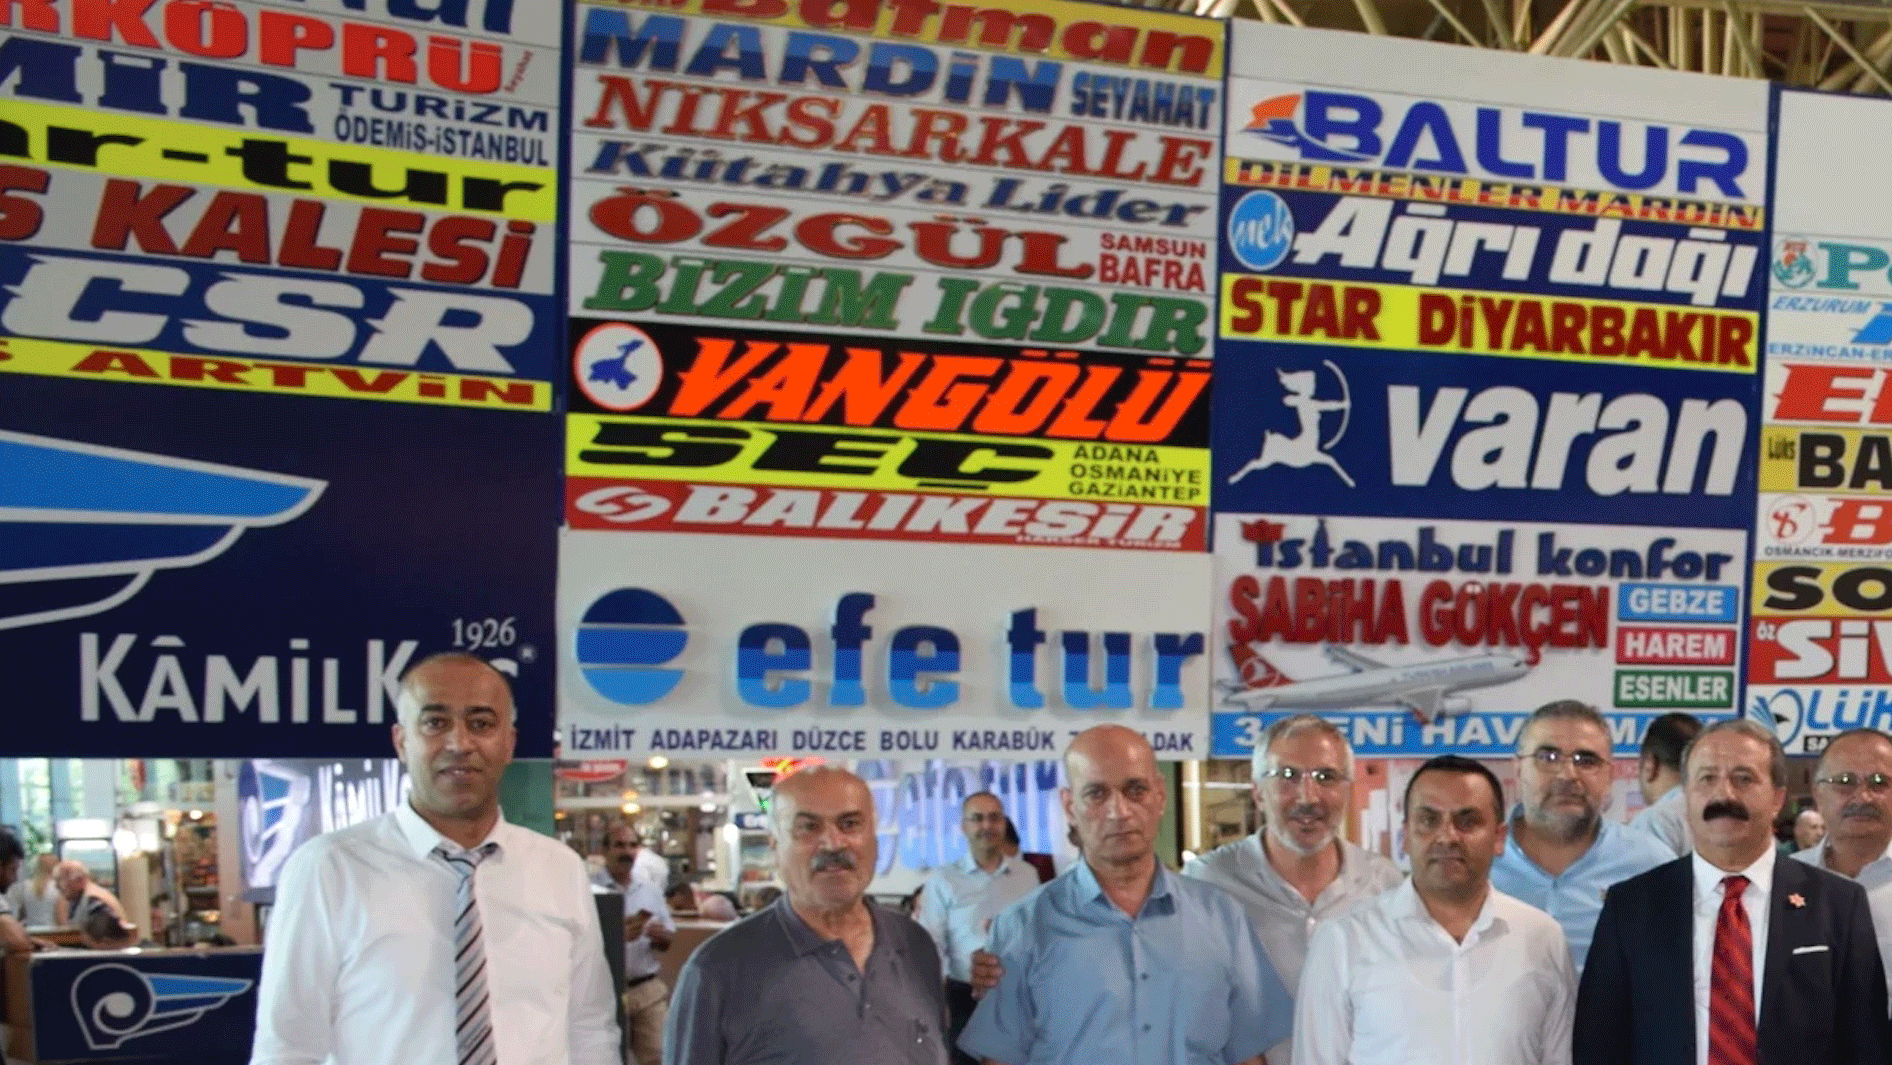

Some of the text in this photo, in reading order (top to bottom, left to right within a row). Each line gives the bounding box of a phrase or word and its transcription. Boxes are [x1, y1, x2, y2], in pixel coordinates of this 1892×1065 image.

[1070, 71, 1215, 130] SEYAHAT
[1300, 90, 1749, 198] BALTUR
[584, 141, 967, 206] Kütahya
[981, 178, 1209, 227] Lider
[589, 187, 1095, 278] ÖZGÜL
[1100, 232, 1205, 259] SAMSUN
[1099, 253, 1205, 292] BAFRA
[1, 254, 535, 373] CSR
[1231, 277, 1381, 341] STAR
[1773, 296, 1871, 314] ERZURUM
[668, 336, 1211, 441] VANGÖLÜ
[579, 421, 1055, 489] SEÇ
[1073, 444, 1160, 463] ADANA
[1387, 384, 1748, 495] varan
[1537, 531, 1733, 580] konfor
[1419, 580, 1611, 667] GÖKÇEN
[1629, 587, 1724, 616] GEBZE
[452, 616, 516, 650] 1926
[736, 592, 1205, 708] efe tur
[1626, 632, 1726, 659] HAREM
[1620, 674, 1729, 702] ESENLER
[571, 726, 635, 751] İZMİT
[651, 730, 777, 751] ADAPAZARI
[792, 727, 866, 753] DÜZCE
[880, 730, 938, 752] BOLU
[952, 728, 1054, 752] KARABÜK
